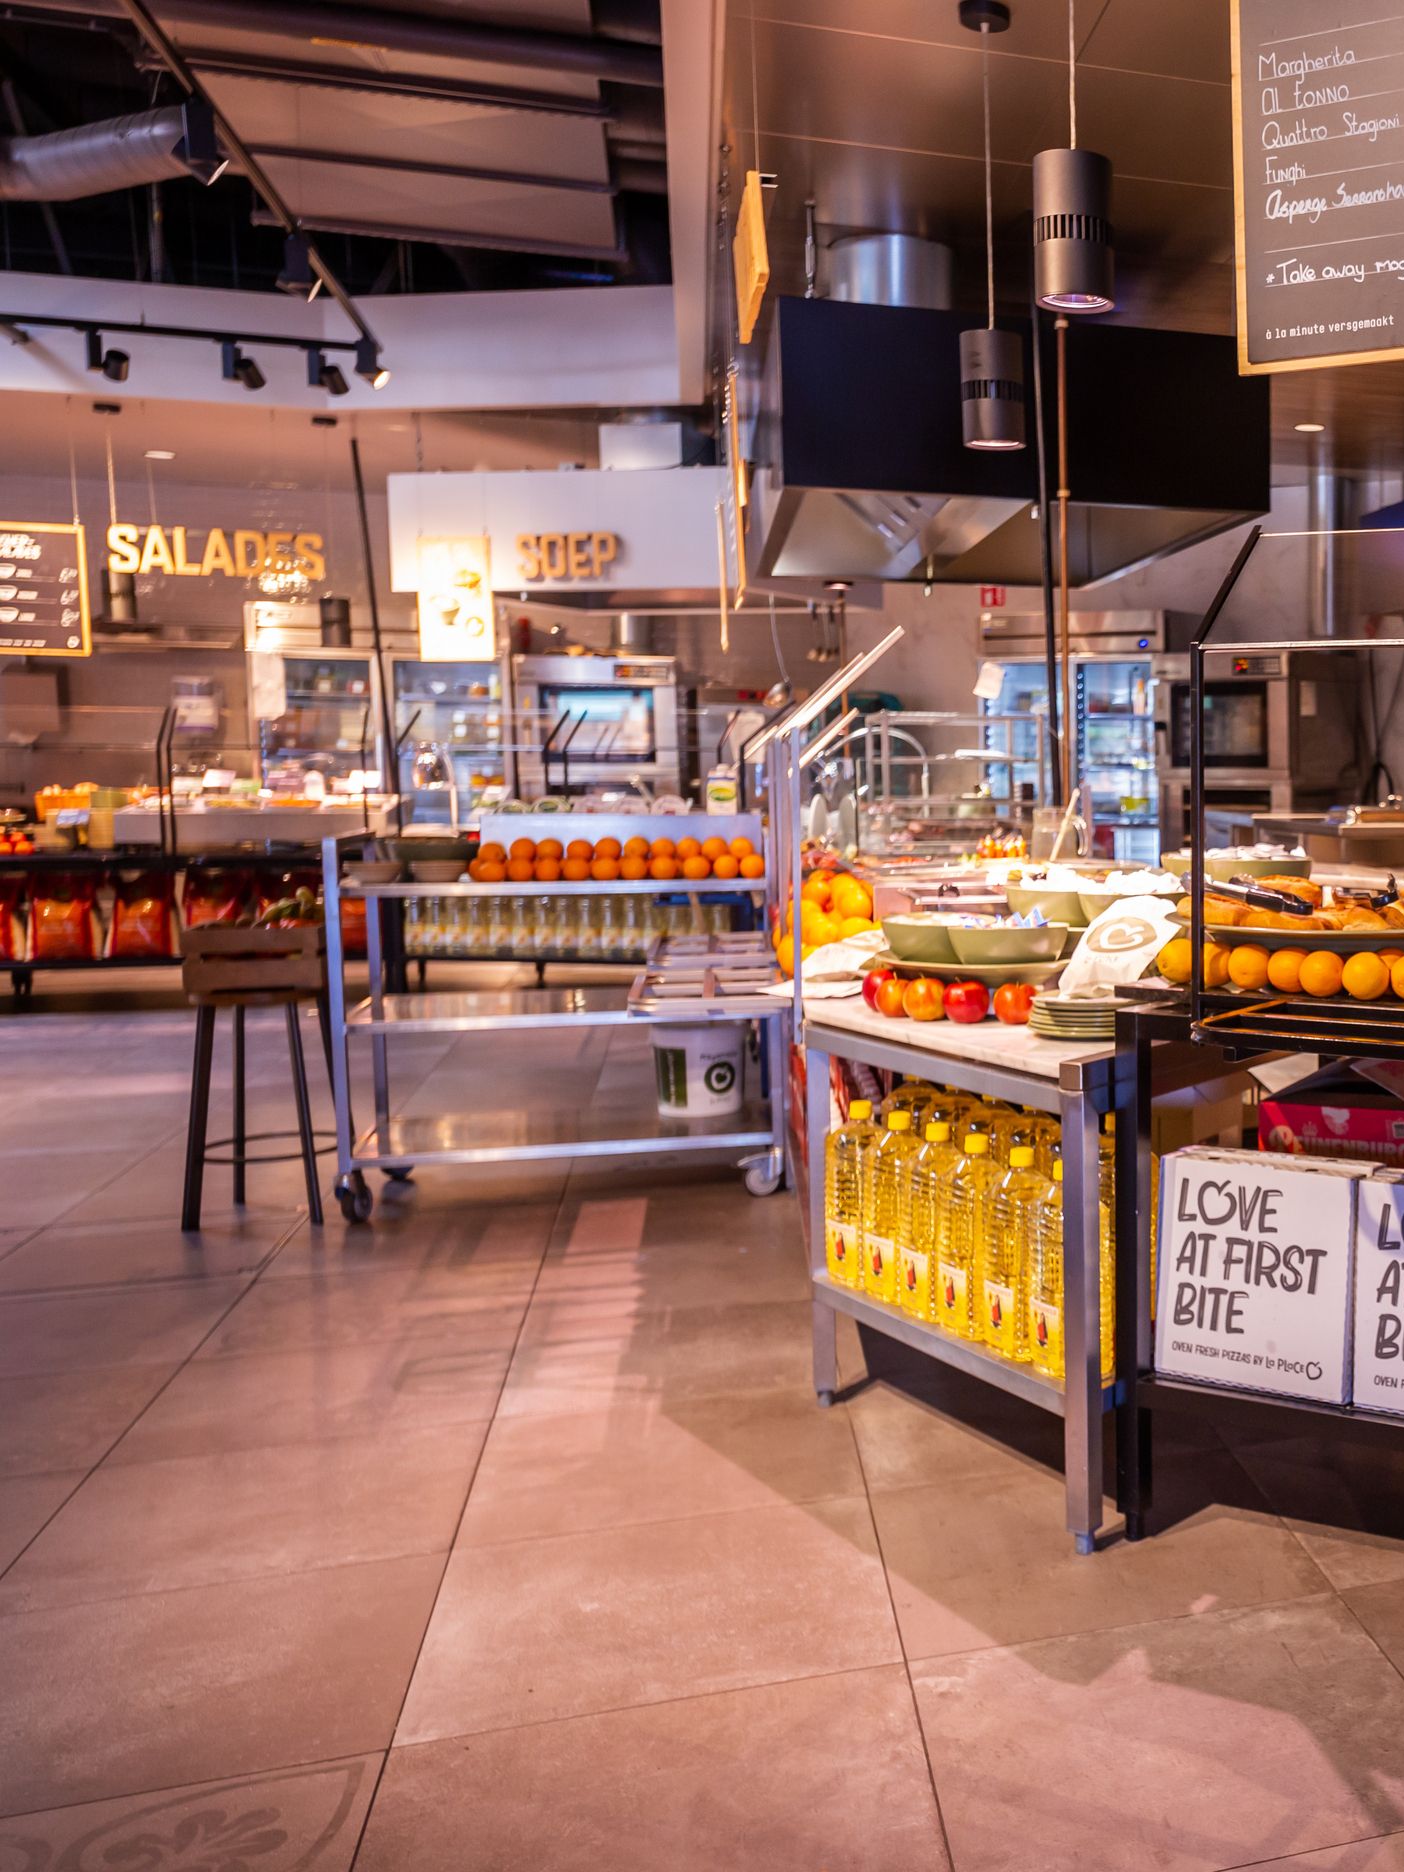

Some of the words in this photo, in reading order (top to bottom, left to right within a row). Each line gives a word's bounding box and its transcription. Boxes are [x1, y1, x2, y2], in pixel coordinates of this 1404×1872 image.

[1258, 46, 1357, 83] Margherita
[1261, 119, 1328, 149] Quattro
[1343, 112, 1400, 142] Stagioni
[1276, 258, 1317, 285] Take
[1321, 264, 1365, 282] away
[1275, 327, 1287, 339] la
[1289, 322, 1326, 338] minute
[1328, 314, 1395, 334] versgemaakt
[107, 523, 326, 580] SALADES
[515, 531, 619, 581] SOEP
[1177, 1178, 1284, 1234] LOVE
[1176, 1231, 1217, 1279] AT
[1222, 1236, 1328, 1295] FIRST
[1173, 1281, 1250, 1335] BITE
[1172, 1341, 1193, 1353] OVEN
[1195, 1345, 1219, 1358] FRESH
[1221, 1349, 1251, 1364] PIZZAS
[1253, 1355, 1263, 1366] BY
[1374, 1374, 1398, 1389] OVEN
